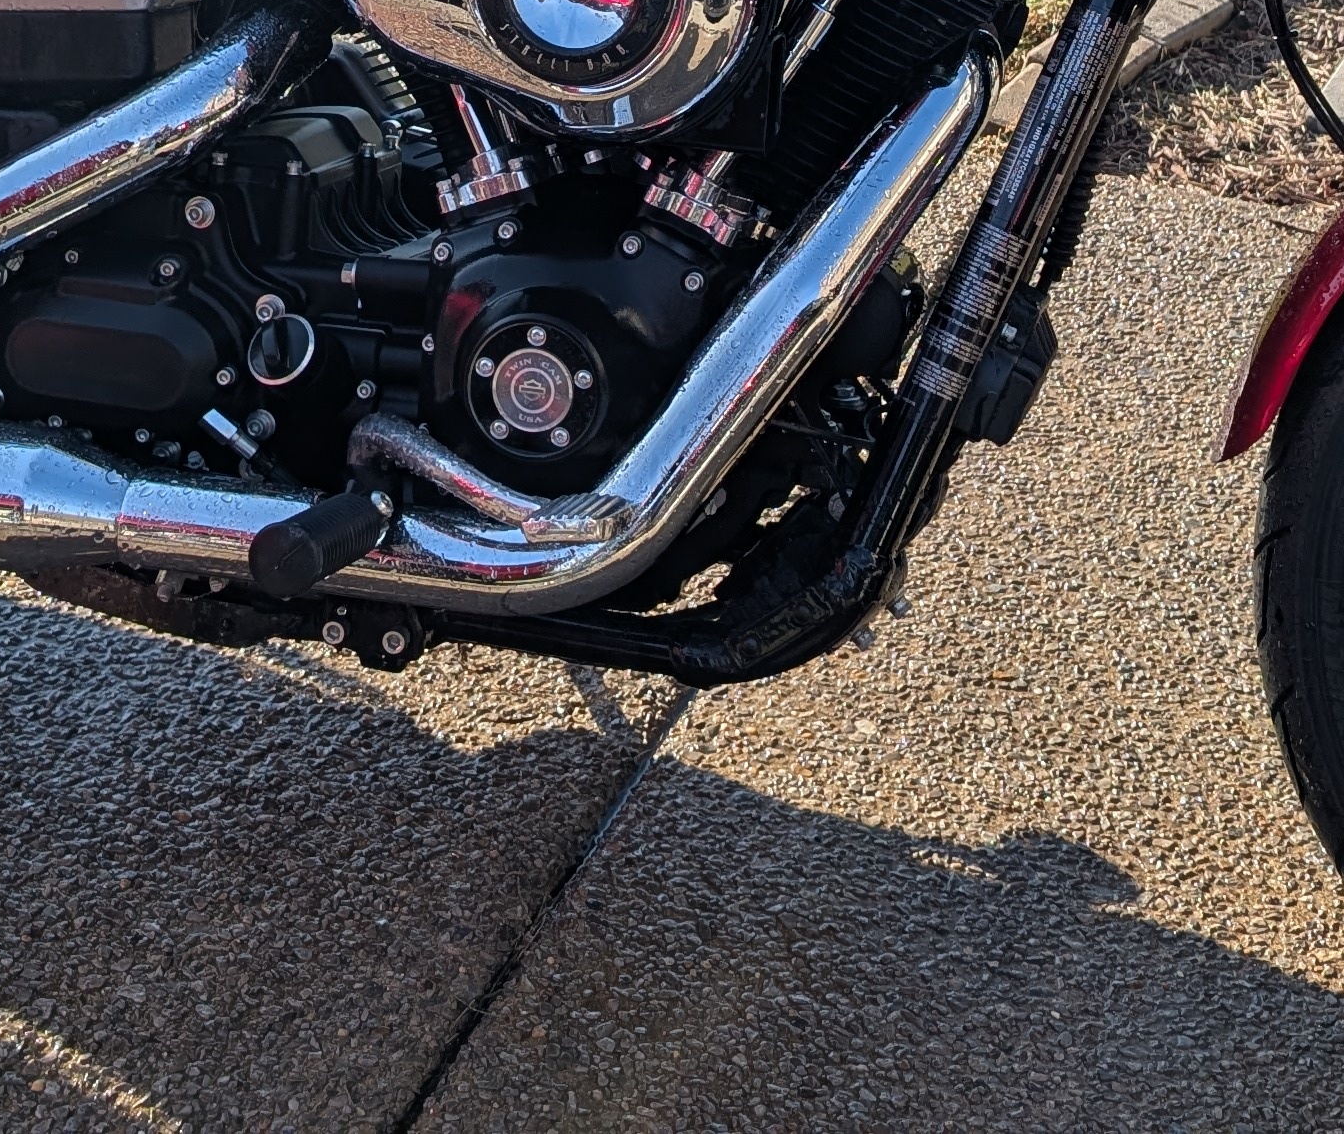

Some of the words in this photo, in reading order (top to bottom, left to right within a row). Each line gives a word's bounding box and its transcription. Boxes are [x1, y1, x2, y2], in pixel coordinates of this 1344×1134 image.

[499, 22, 570, 72] STREET
[585, 43, 628, 72] BOB
[504, 357, 533, 378] TWIN
[540, 361, 563, 386] CAM
[518, 413, 543, 423] USA
